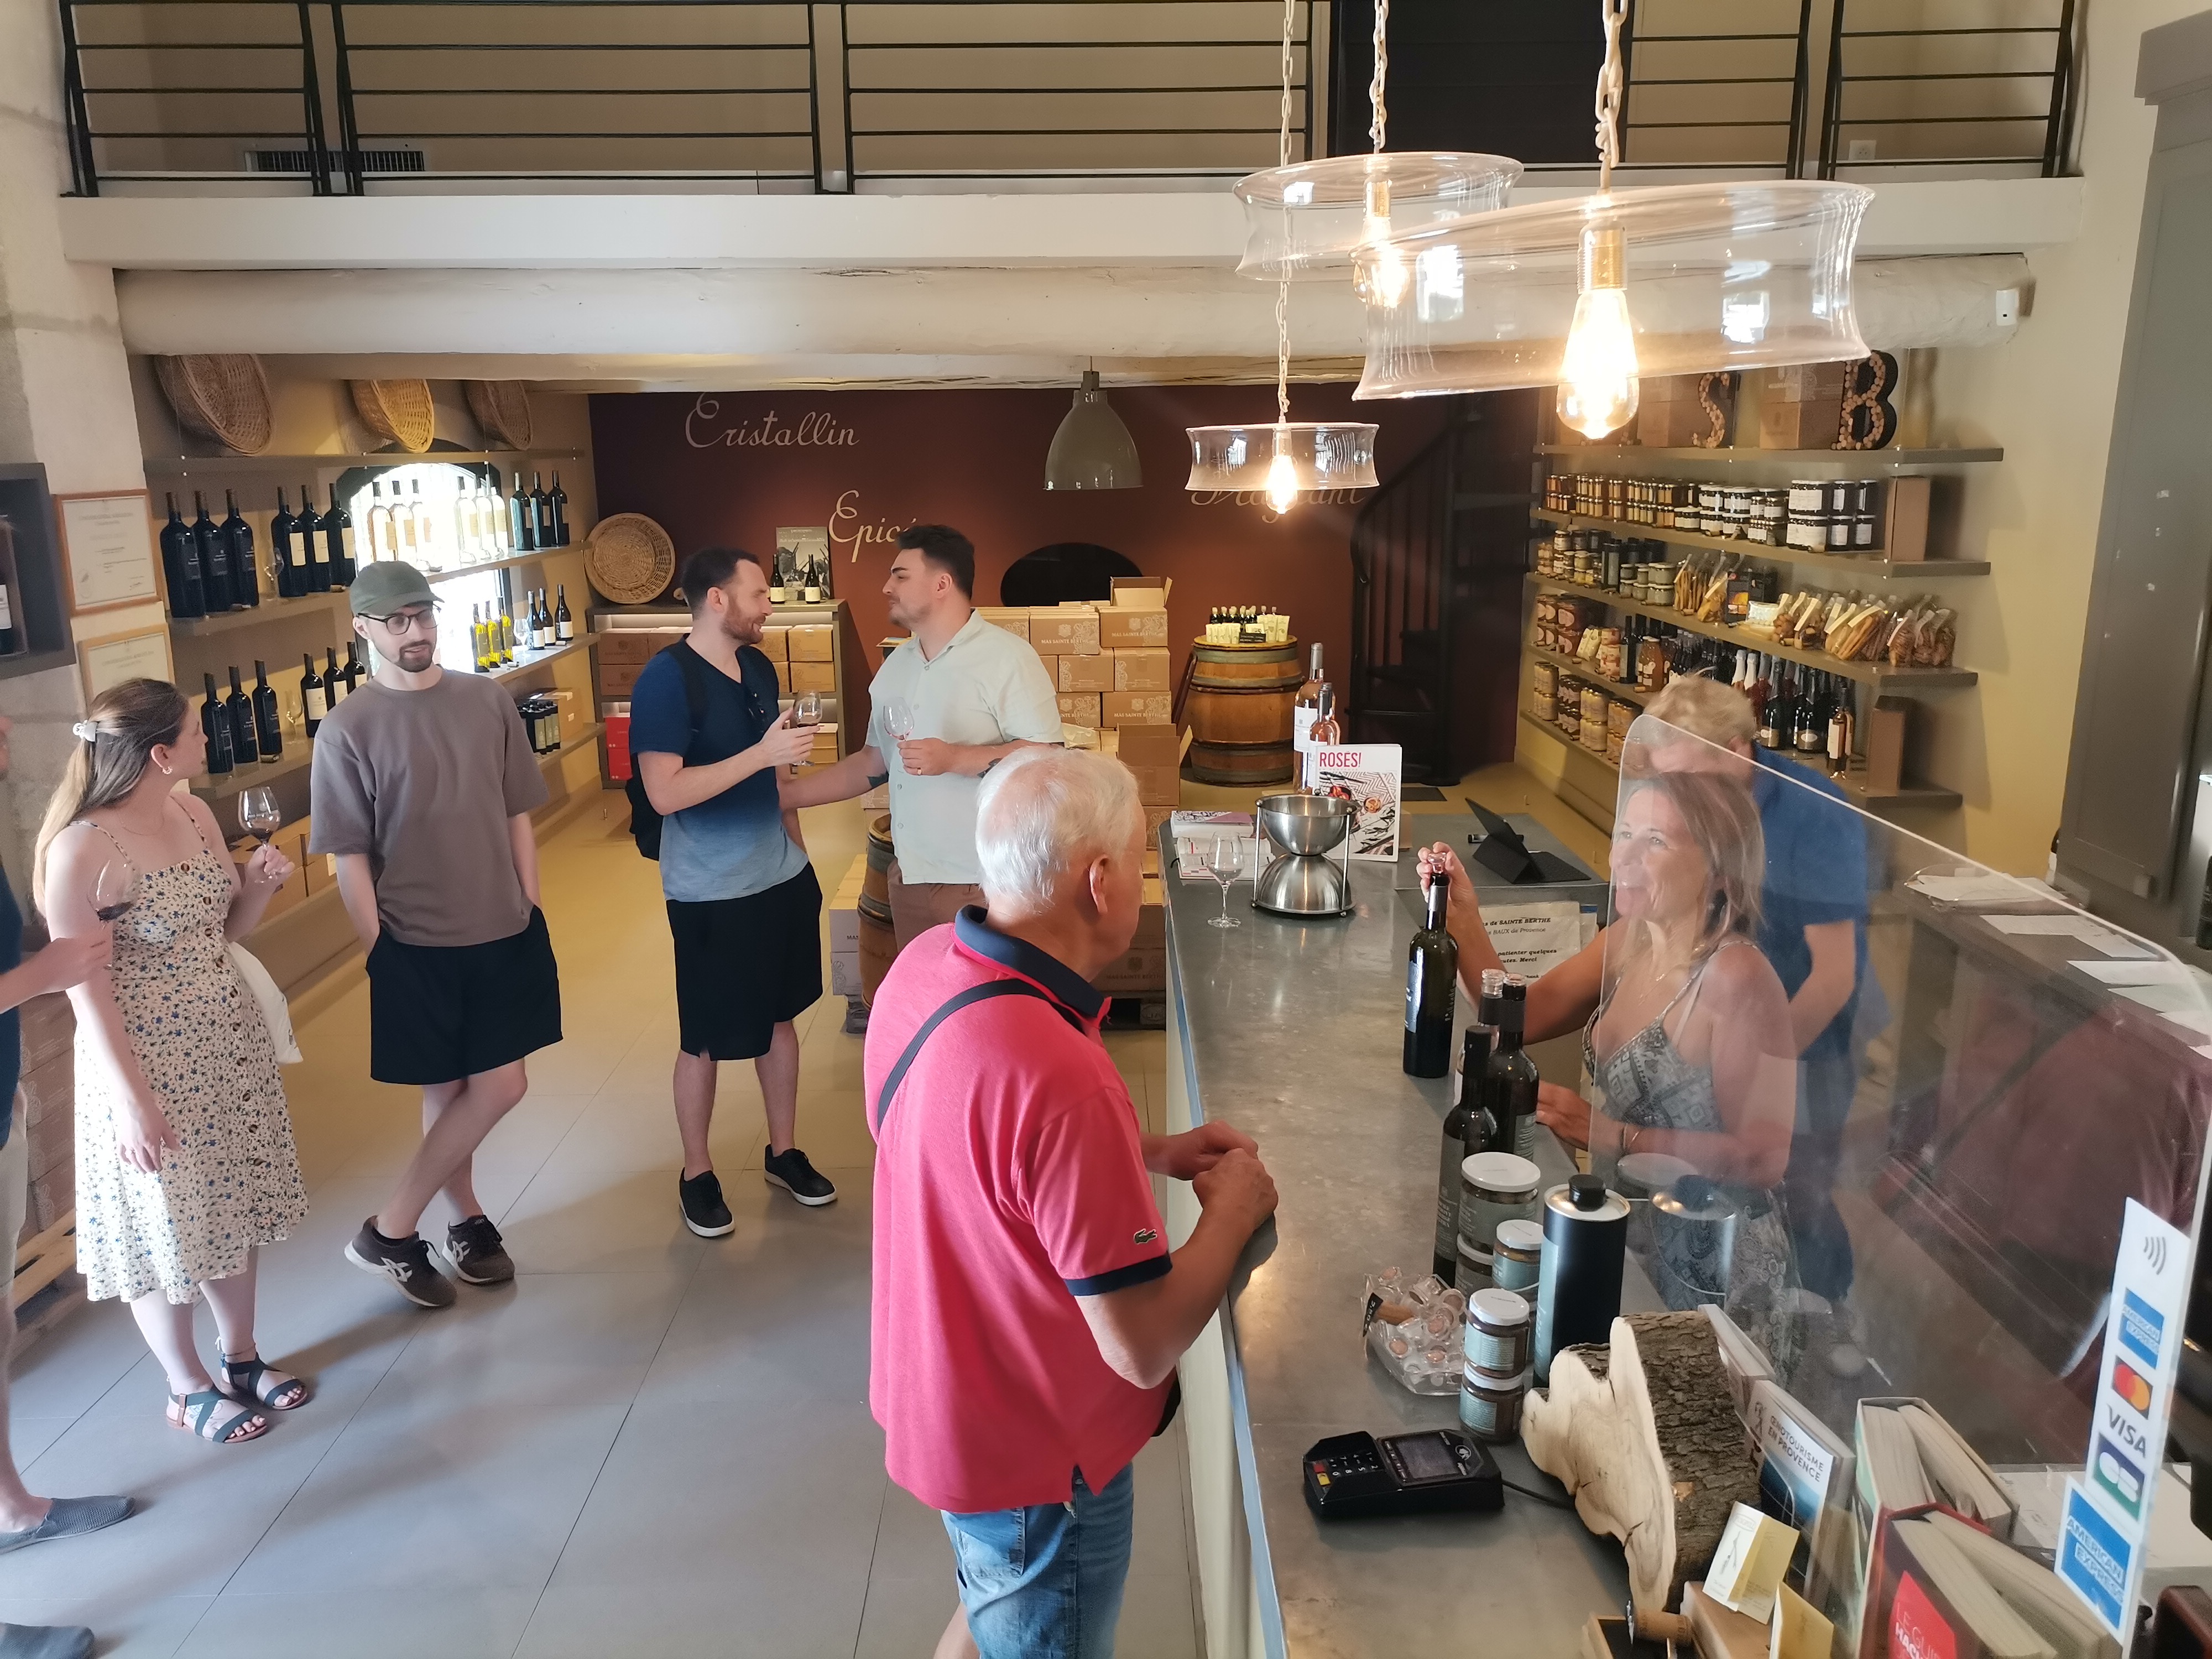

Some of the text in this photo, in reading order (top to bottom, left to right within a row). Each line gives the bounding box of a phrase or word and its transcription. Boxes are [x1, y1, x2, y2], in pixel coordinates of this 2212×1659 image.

[685, 392, 860, 448] Cristallin
[829, 489, 916, 563] Epic
[2107, 1404, 2147, 1459] VISA
[1778, 1437, 1822, 1482] PROVENCE
[2067, 1517, 2125, 1584] AMERICAN
[2076, 1546, 2124, 1603] EXPRESS
[1896, 1621, 1923, 1659] HAC
[1912, 1626, 1940, 1659] GUI
